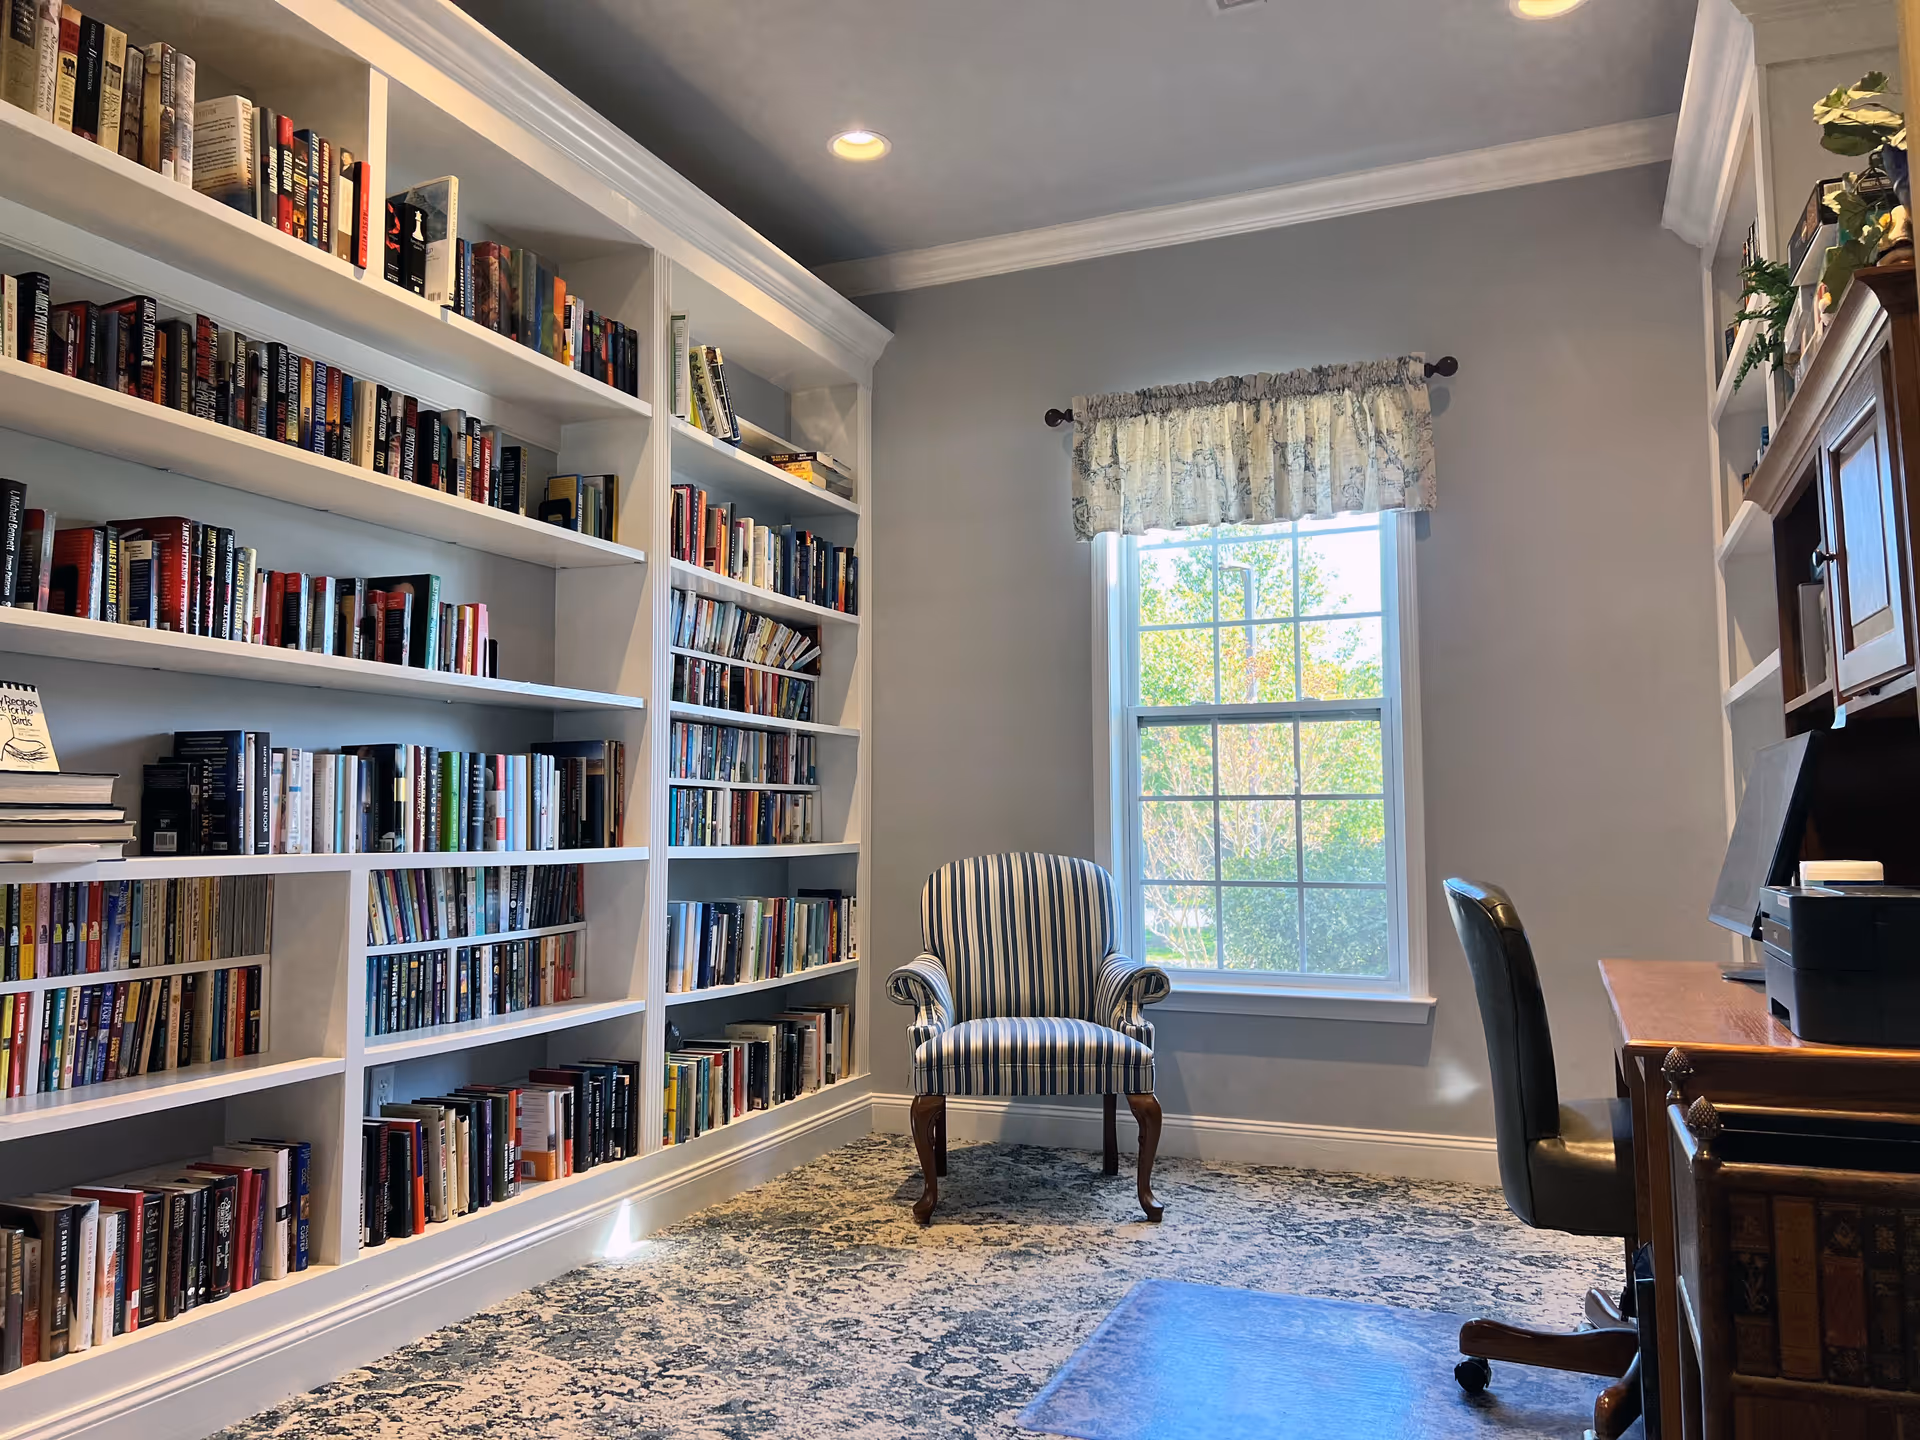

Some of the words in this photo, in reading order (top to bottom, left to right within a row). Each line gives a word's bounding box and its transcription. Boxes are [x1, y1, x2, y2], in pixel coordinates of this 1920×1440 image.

[242, 102, 254, 155] DEVOTION
[34, 290, 48, 314] JAMES
[143, 299, 156, 321] JAMES
[33, 314, 47, 353] PATTERSON
[142, 322, 155, 360] PATTERSON
[236, 338, 246, 356] JAMES
[278, 347, 287, 364] JAMES
[236, 356, 245, 388] PATTERSON
[277, 364, 286, 393] PATTERSON
[315, 363, 327, 381] FOUR
[315, 383, 326, 404] BLIND
[380, 398, 388, 414] JAMES
[314, 405, 325, 423] MICE
[379, 414, 388, 442] PATTERSON
[376, 451, 385, 468] TOYS
[404, 431, 416, 470] PATTERSON
[472, 440, 480, 468] PATTERSON
[9, 494, 20, 523] Michael
[6, 523, 18, 551] Bennett
[182, 522, 190, 544] JAMES
[207, 528, 217, 545] JAMES
[5, 553, 14, 570] James
[108, 540, 117, 563] JAMES
[181, 544, 189, 580] PATTERSON
[206, 545, 216, 578] PATTERSON
[225, 552, 233, 583] PATTERSON
[236, 562, 244, 585] JAMES
[3, 571, 13, 596] Patterson
[108, 564, 117, 603] PATTERSON
[235, 587, 244, 629] PATTERSON
[4, 694, 38, 708] Recipes
[11, 714, 33, 727] Birds
[11, 1234, 21, 1265] SANDRA
[60, 1229, 68, 1262] SANDRA
[11, 1266, 21, 1295] BROWN
[59, 1264, 67, 1294] BROWN
